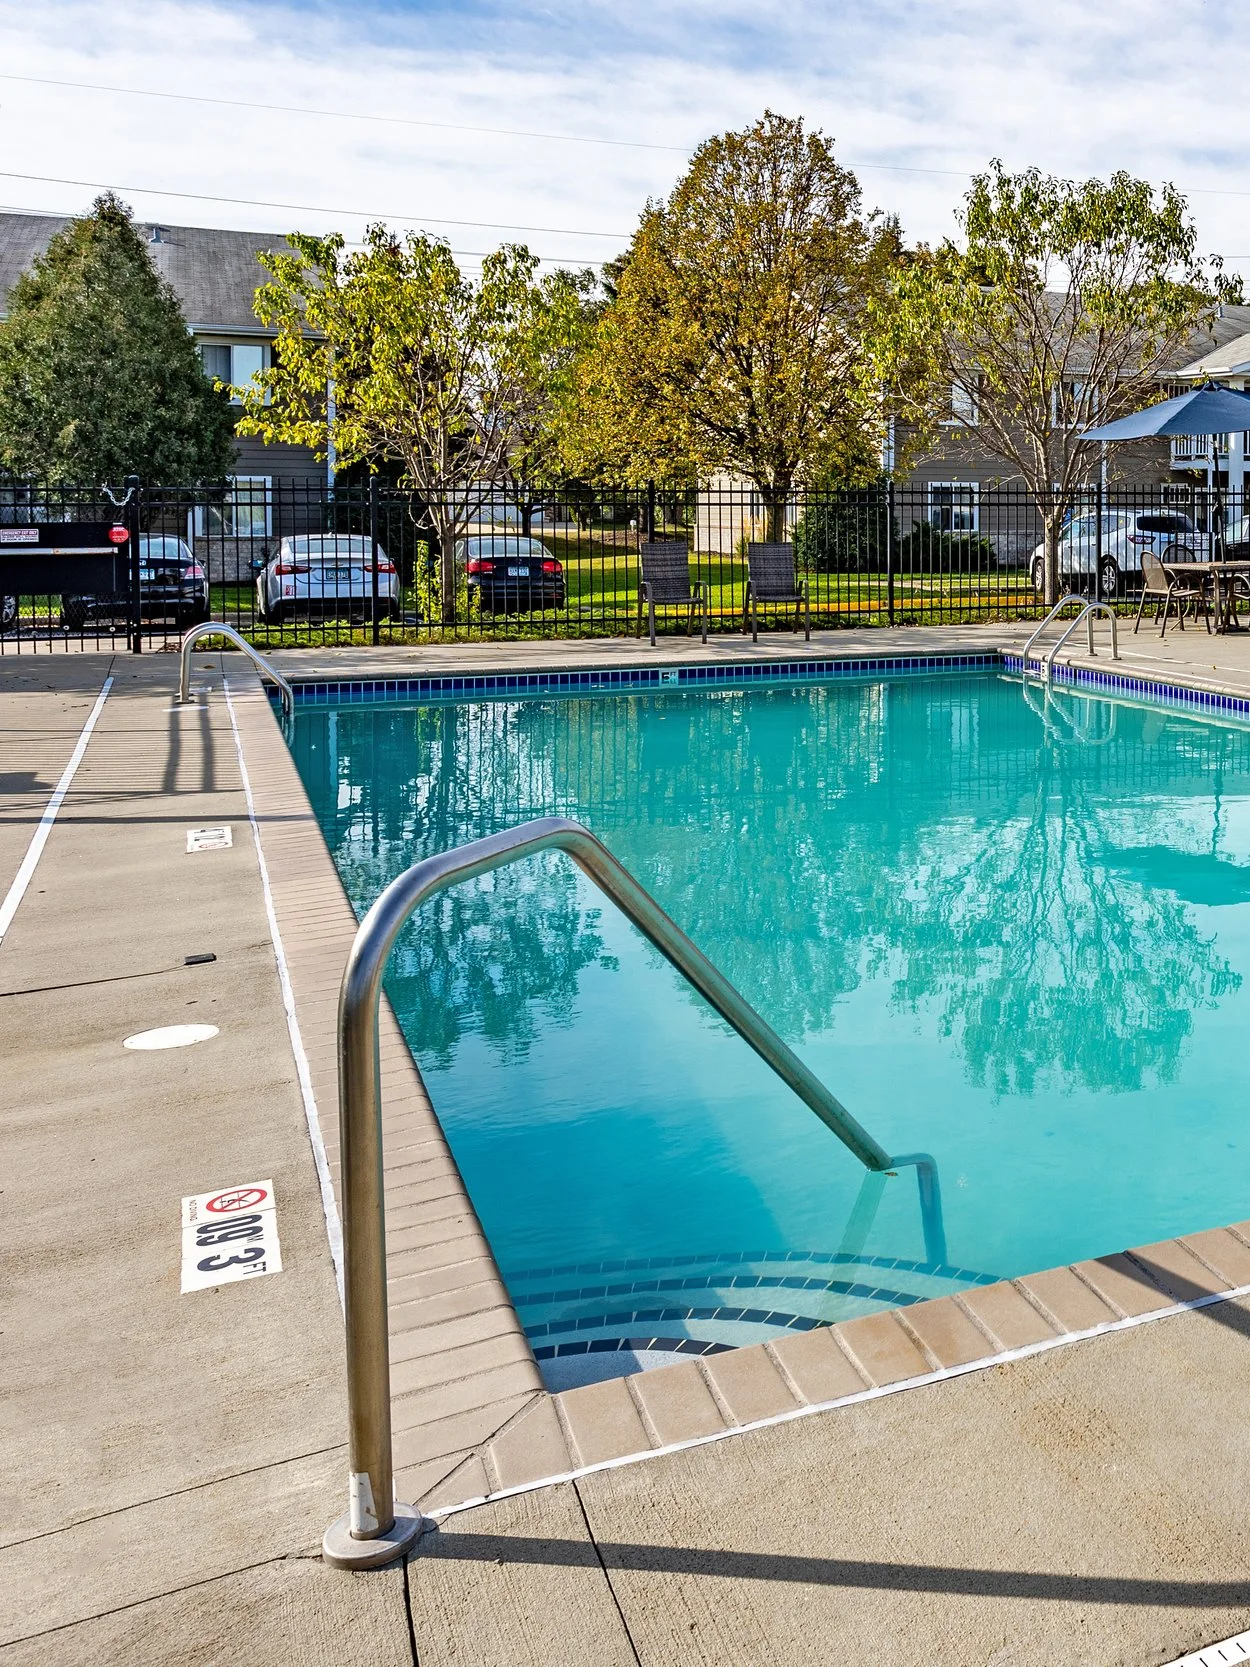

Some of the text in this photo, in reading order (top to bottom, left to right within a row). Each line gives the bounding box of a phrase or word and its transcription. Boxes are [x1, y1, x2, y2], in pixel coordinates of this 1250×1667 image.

[246, 1233, 264, 1244] M
[197, 1247, 267, 1275] 3 FT
